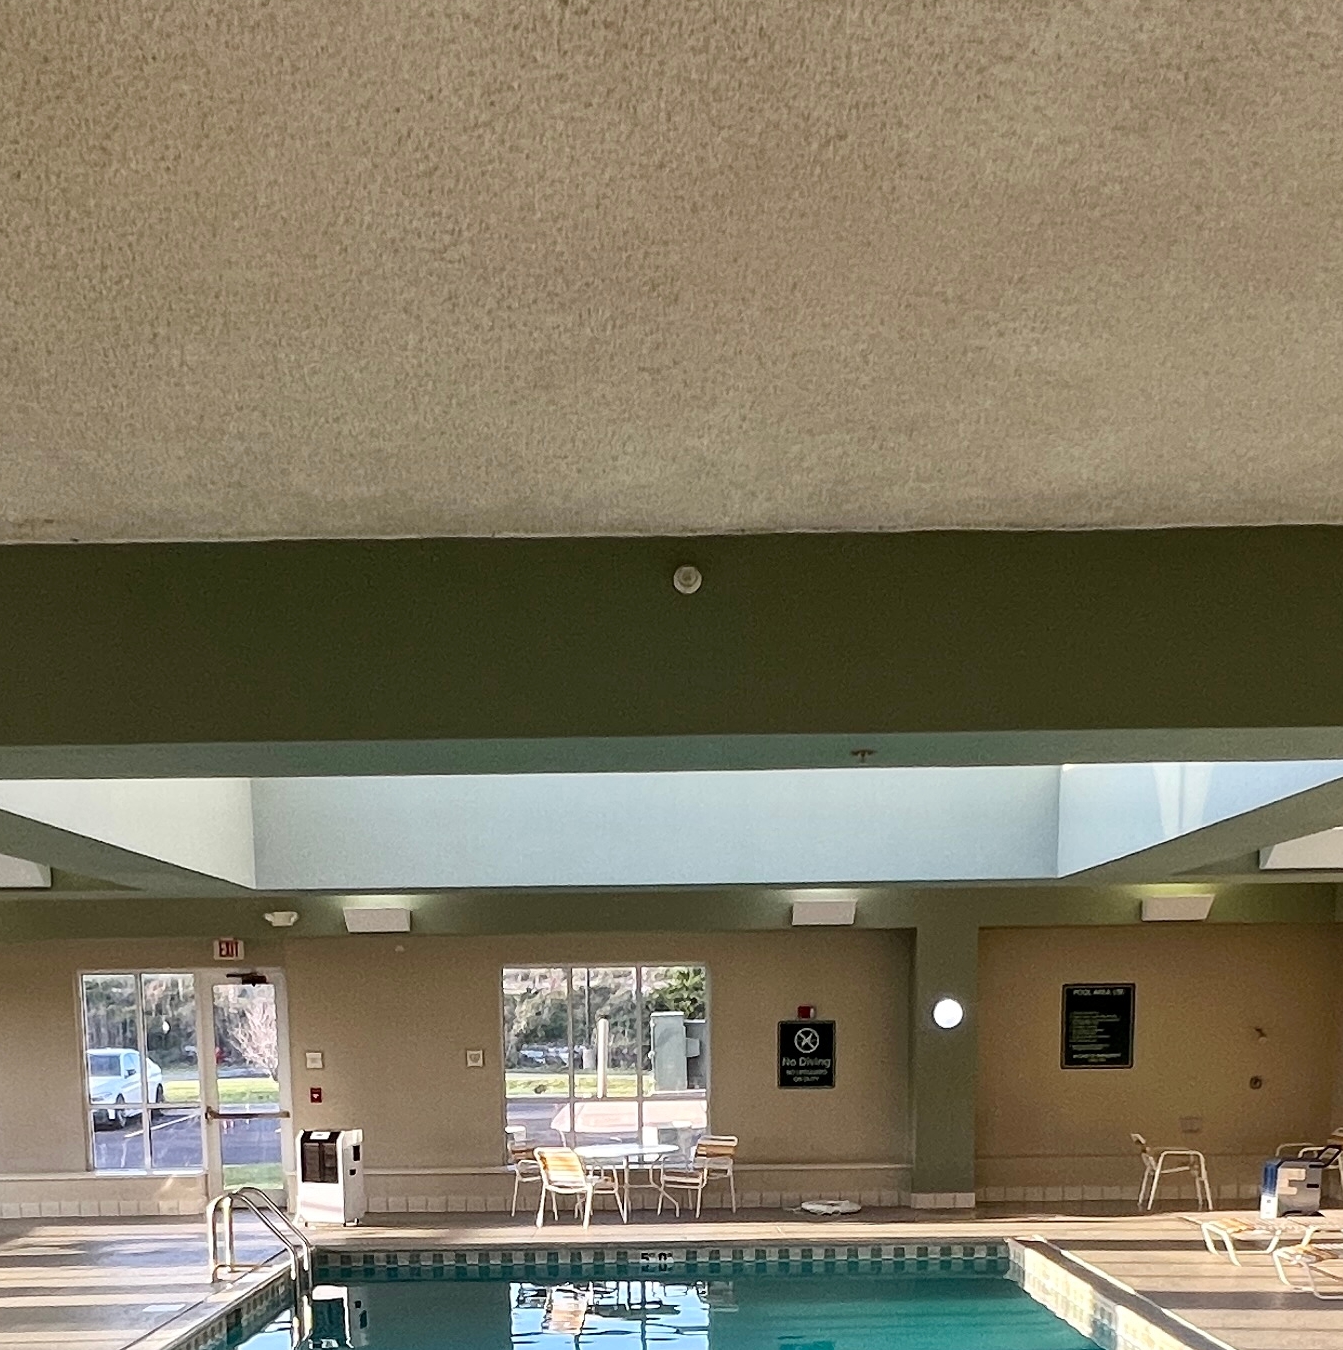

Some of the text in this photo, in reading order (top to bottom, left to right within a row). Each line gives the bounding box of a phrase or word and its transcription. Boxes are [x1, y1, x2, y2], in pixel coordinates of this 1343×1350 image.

[219, 941, 238, 957] EXIT
[782, 1056, 832, 1069] No Diving
